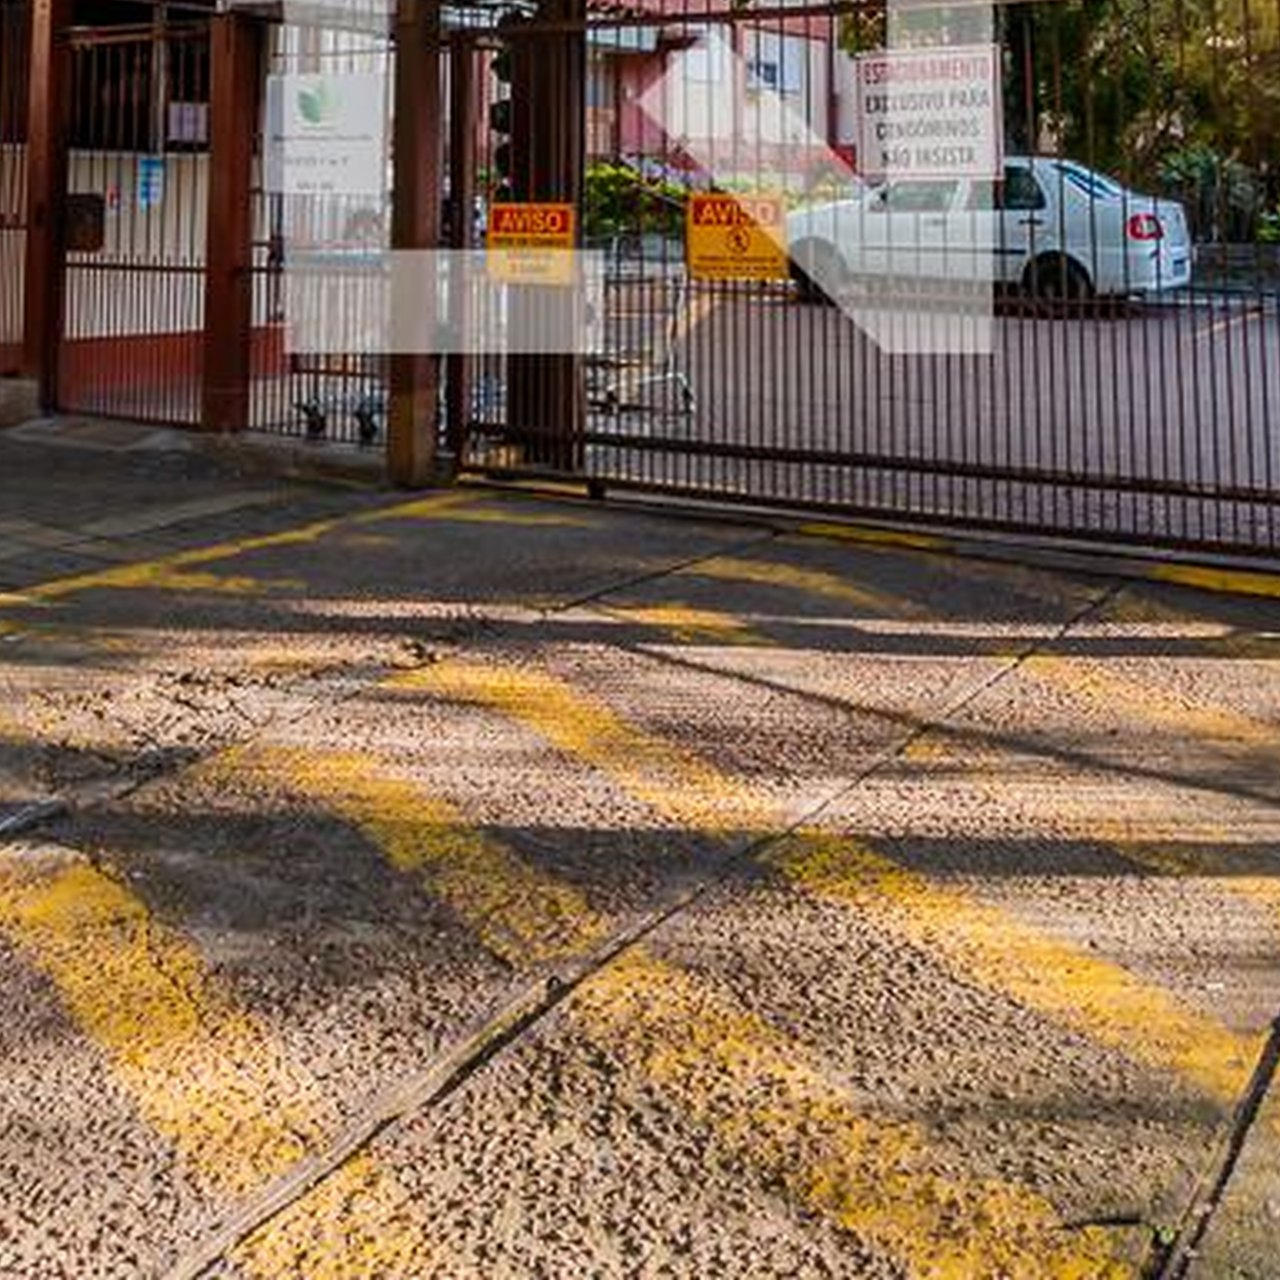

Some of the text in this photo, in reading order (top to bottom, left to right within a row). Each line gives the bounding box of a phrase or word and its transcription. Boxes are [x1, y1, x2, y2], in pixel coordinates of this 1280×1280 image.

[950, 88, 989, 108] PARA
[499, 211, 563, 232] AVISO
[701, 201, 775, 224] AVISO
